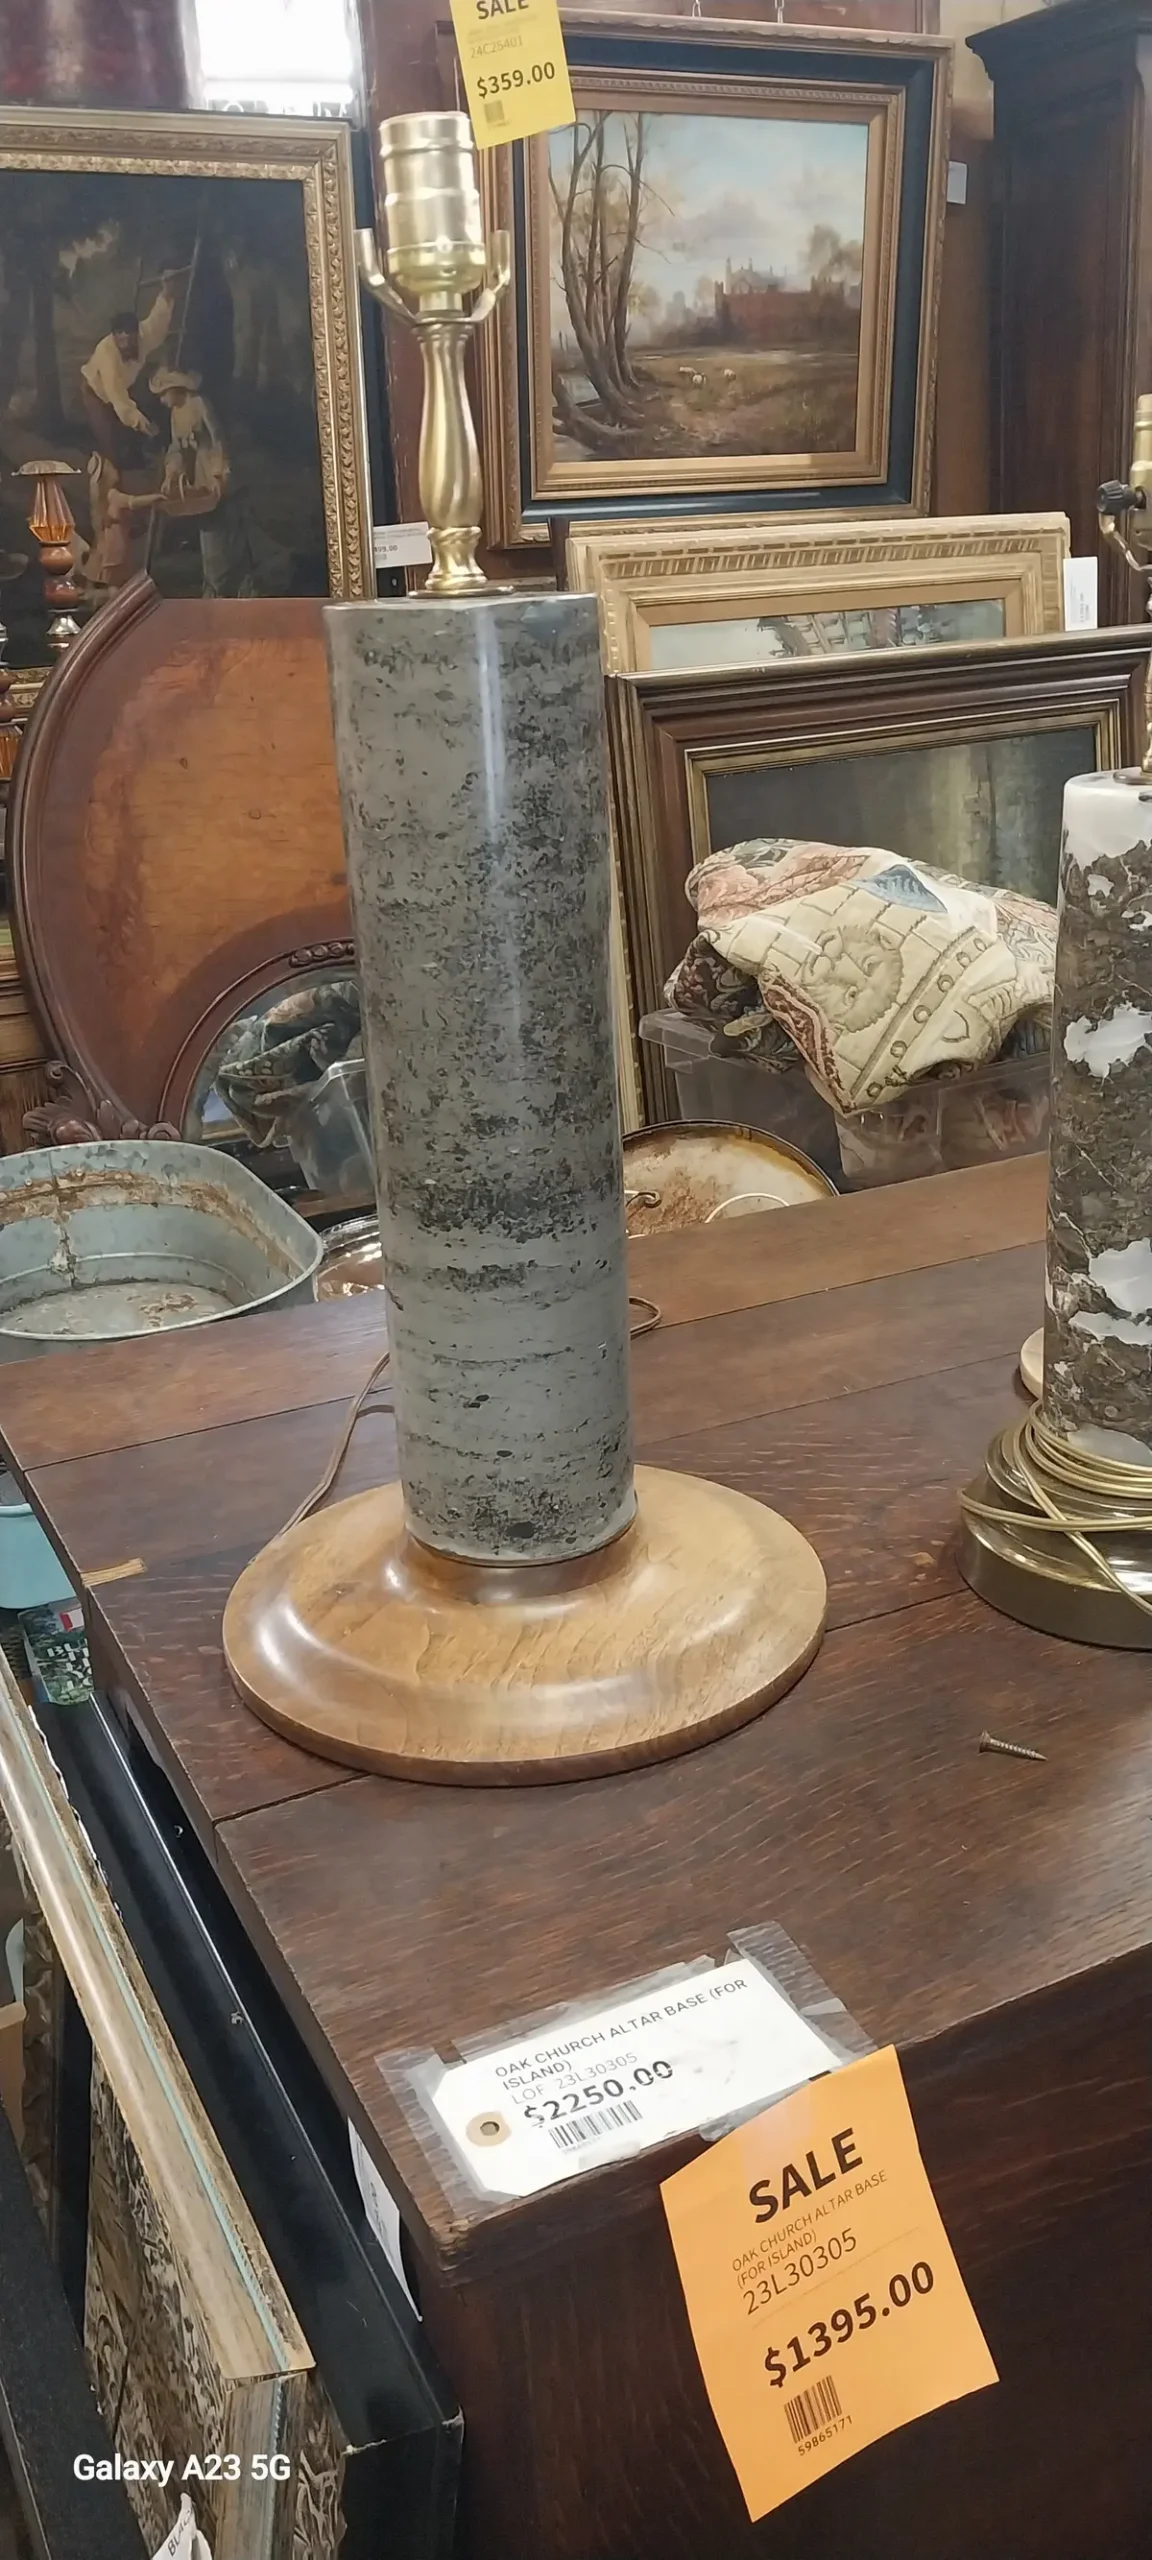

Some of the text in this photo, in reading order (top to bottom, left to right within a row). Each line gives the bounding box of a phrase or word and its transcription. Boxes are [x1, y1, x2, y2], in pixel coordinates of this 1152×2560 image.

[476, 61, 556, 99] $359.00
[495, 1979, 748, 2077] OAK CHURCH ALTAR BASE (FOR
[502, 2060, 572, 2090] ISLAND)
[524, 2060, 673, 2128] $2250.00
[556, 2052, 638, 2089] 23L30305
[749, 2127, 864, 2223] SALE
[732, 2170, 887, 2271] OAK CHURCH ALTAR BASE
[737, 2229, 817, 2289] (FOR ISLAND)
[743, 2228, 857, 2315] 23L30305
[763, 2261, 934, 2388] $1395.00
[798, 2415, 852, 2456] 59865171
